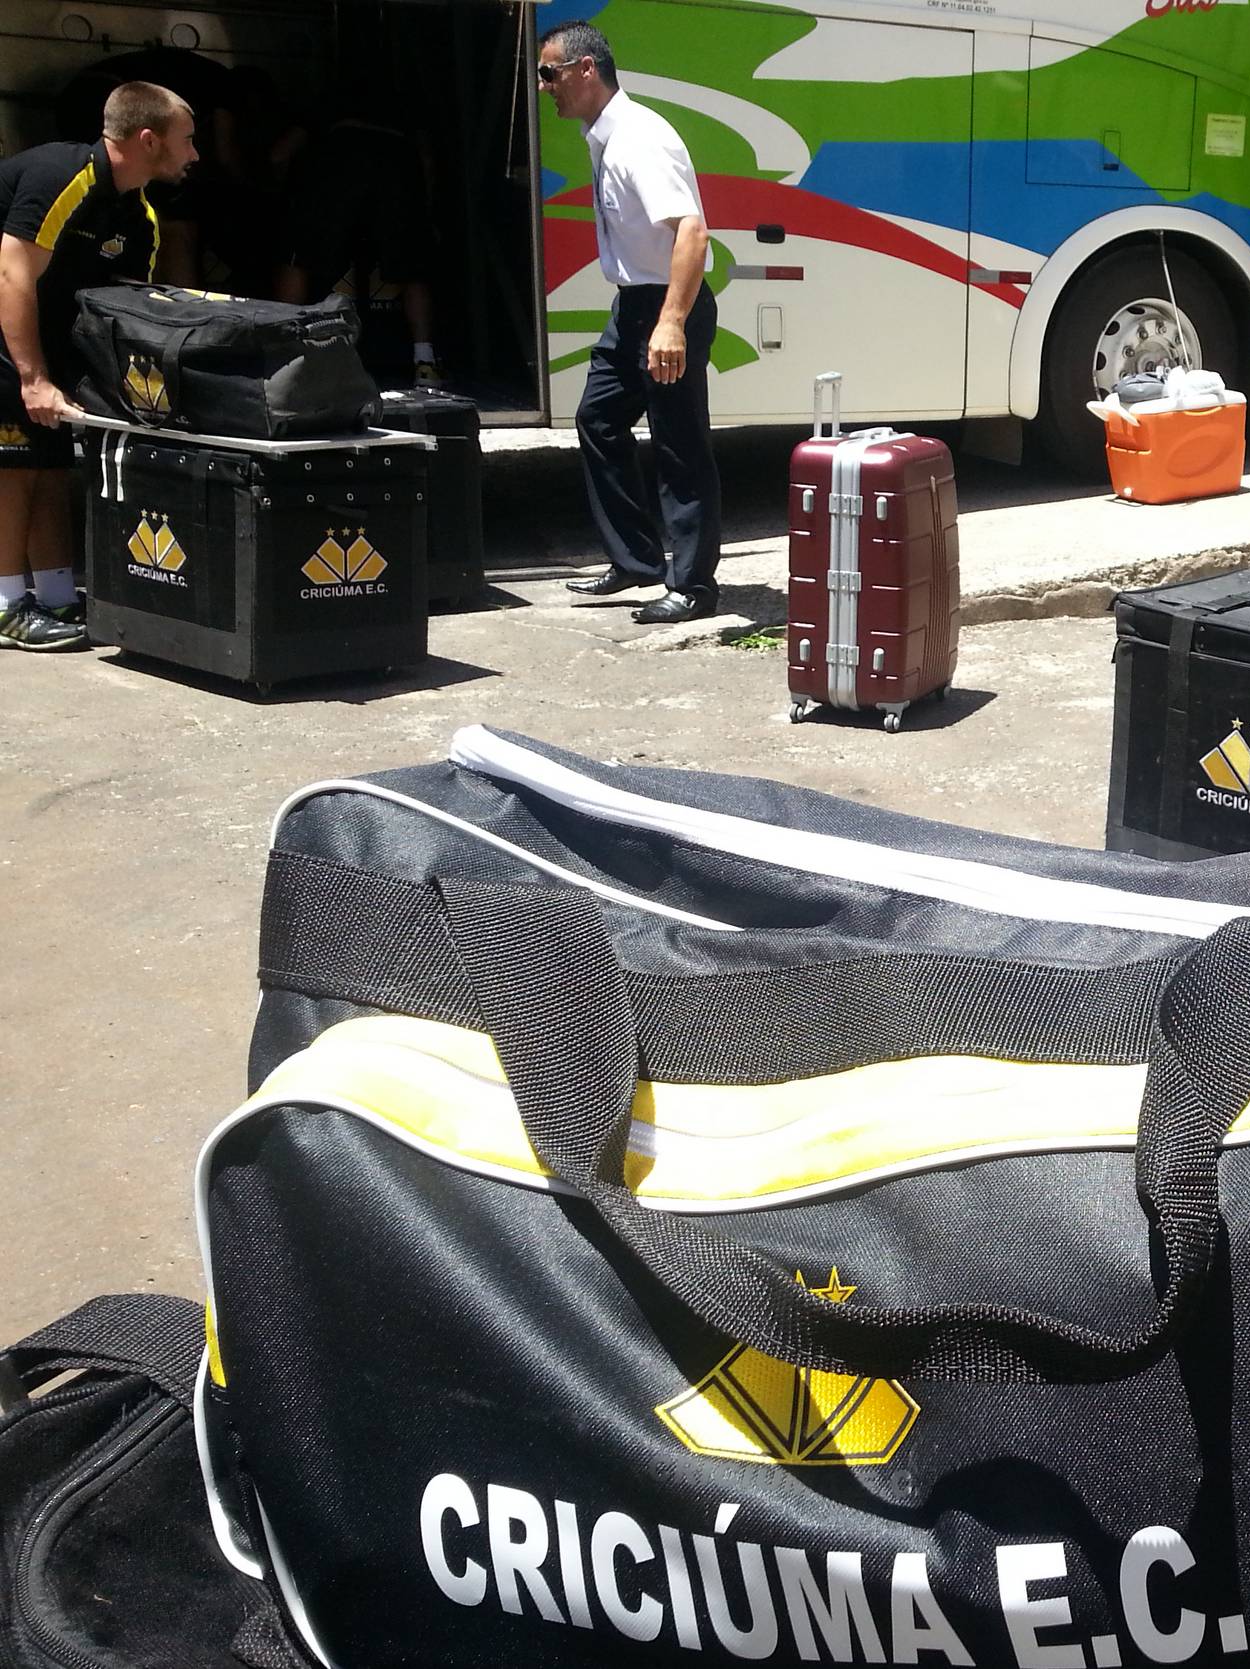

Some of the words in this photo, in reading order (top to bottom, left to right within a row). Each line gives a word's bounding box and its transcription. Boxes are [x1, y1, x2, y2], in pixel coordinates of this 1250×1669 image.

[127, 563, 170, 584] CRICIÚMA
[169, 573, 188, 588] E.C.
[300, 584, 363, 599] CRICIÚMA
[366, 583, 389, 594] E.C.
[419, 1472, 976, 1667] CRICIÚMA
[994, 1524, 1250, 1669] E.C.
